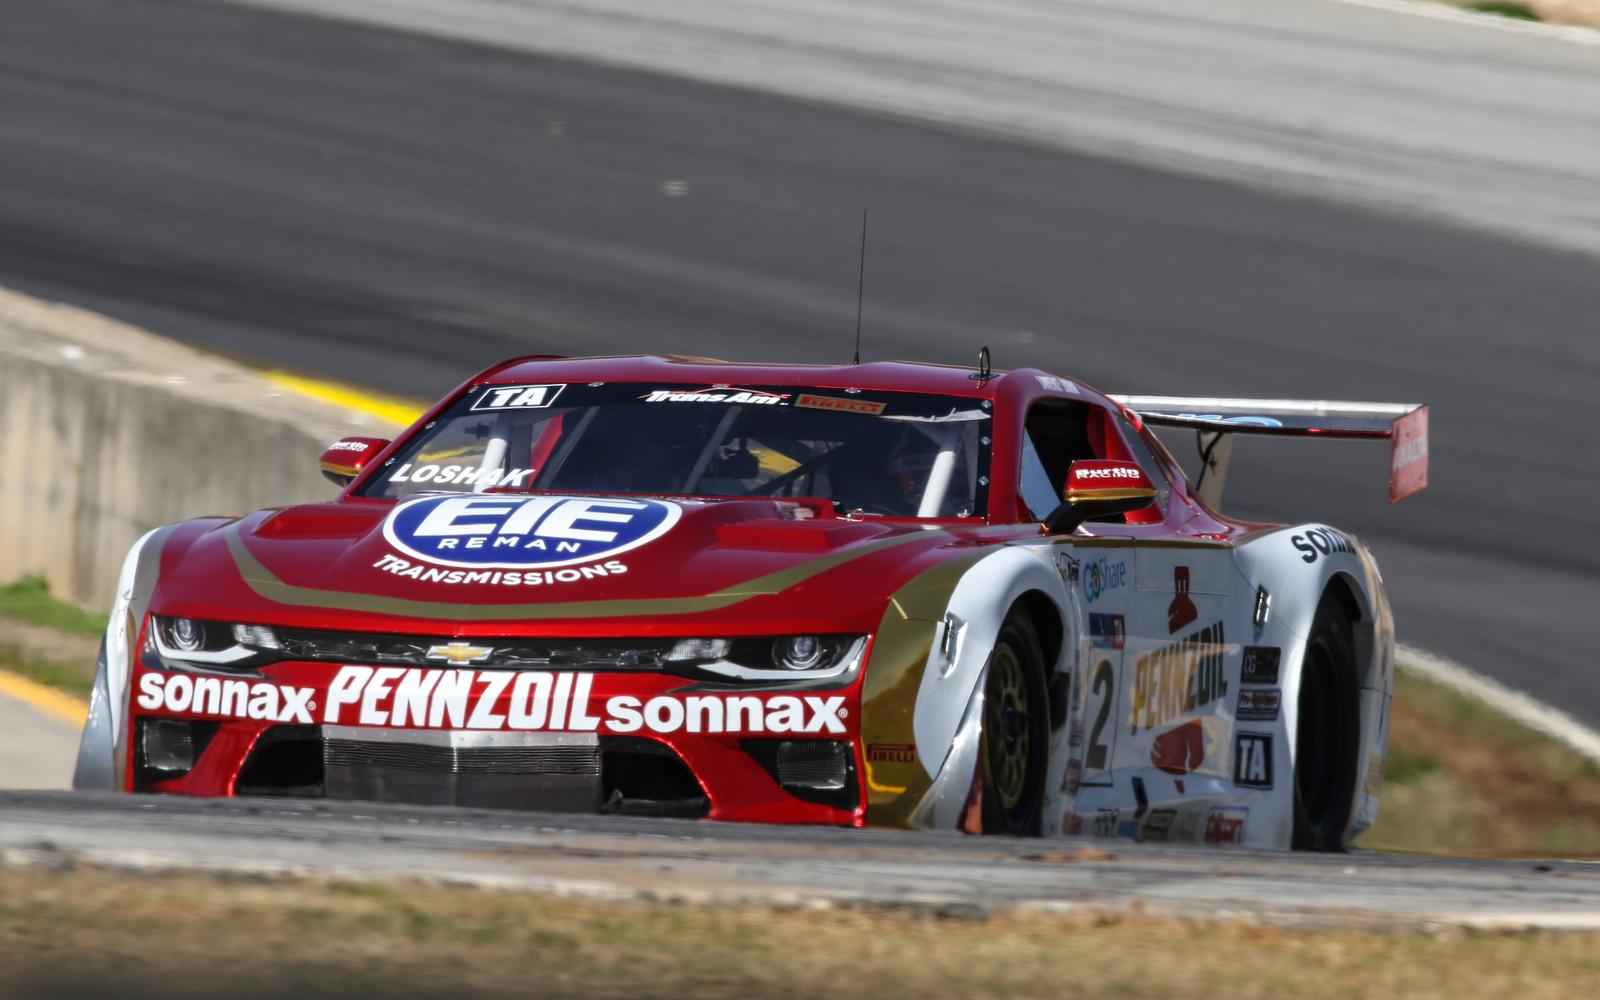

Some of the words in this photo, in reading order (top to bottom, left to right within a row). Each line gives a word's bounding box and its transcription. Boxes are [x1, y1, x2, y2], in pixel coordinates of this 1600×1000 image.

[489, 386, 545, 408] TA
[646, 391, 727, 402] Trans
[722, 392, 781, 405] Am
[389, 463, 534, 487] LOSHAK
[413, 495, 646, 542] EIE
[437, 537, 580, 553] REMAN
[372, 554, 628, 586] TRANSMISSIONS
[1131, 620, 1228, 736] PENNZOIL
[324, 665, 600, 731] PENNZOIL
[1086, 659, 1114, 769] 2
[867, 743, 915, 762] PIRELLI
[1239, 739, 1266, 781] TA
